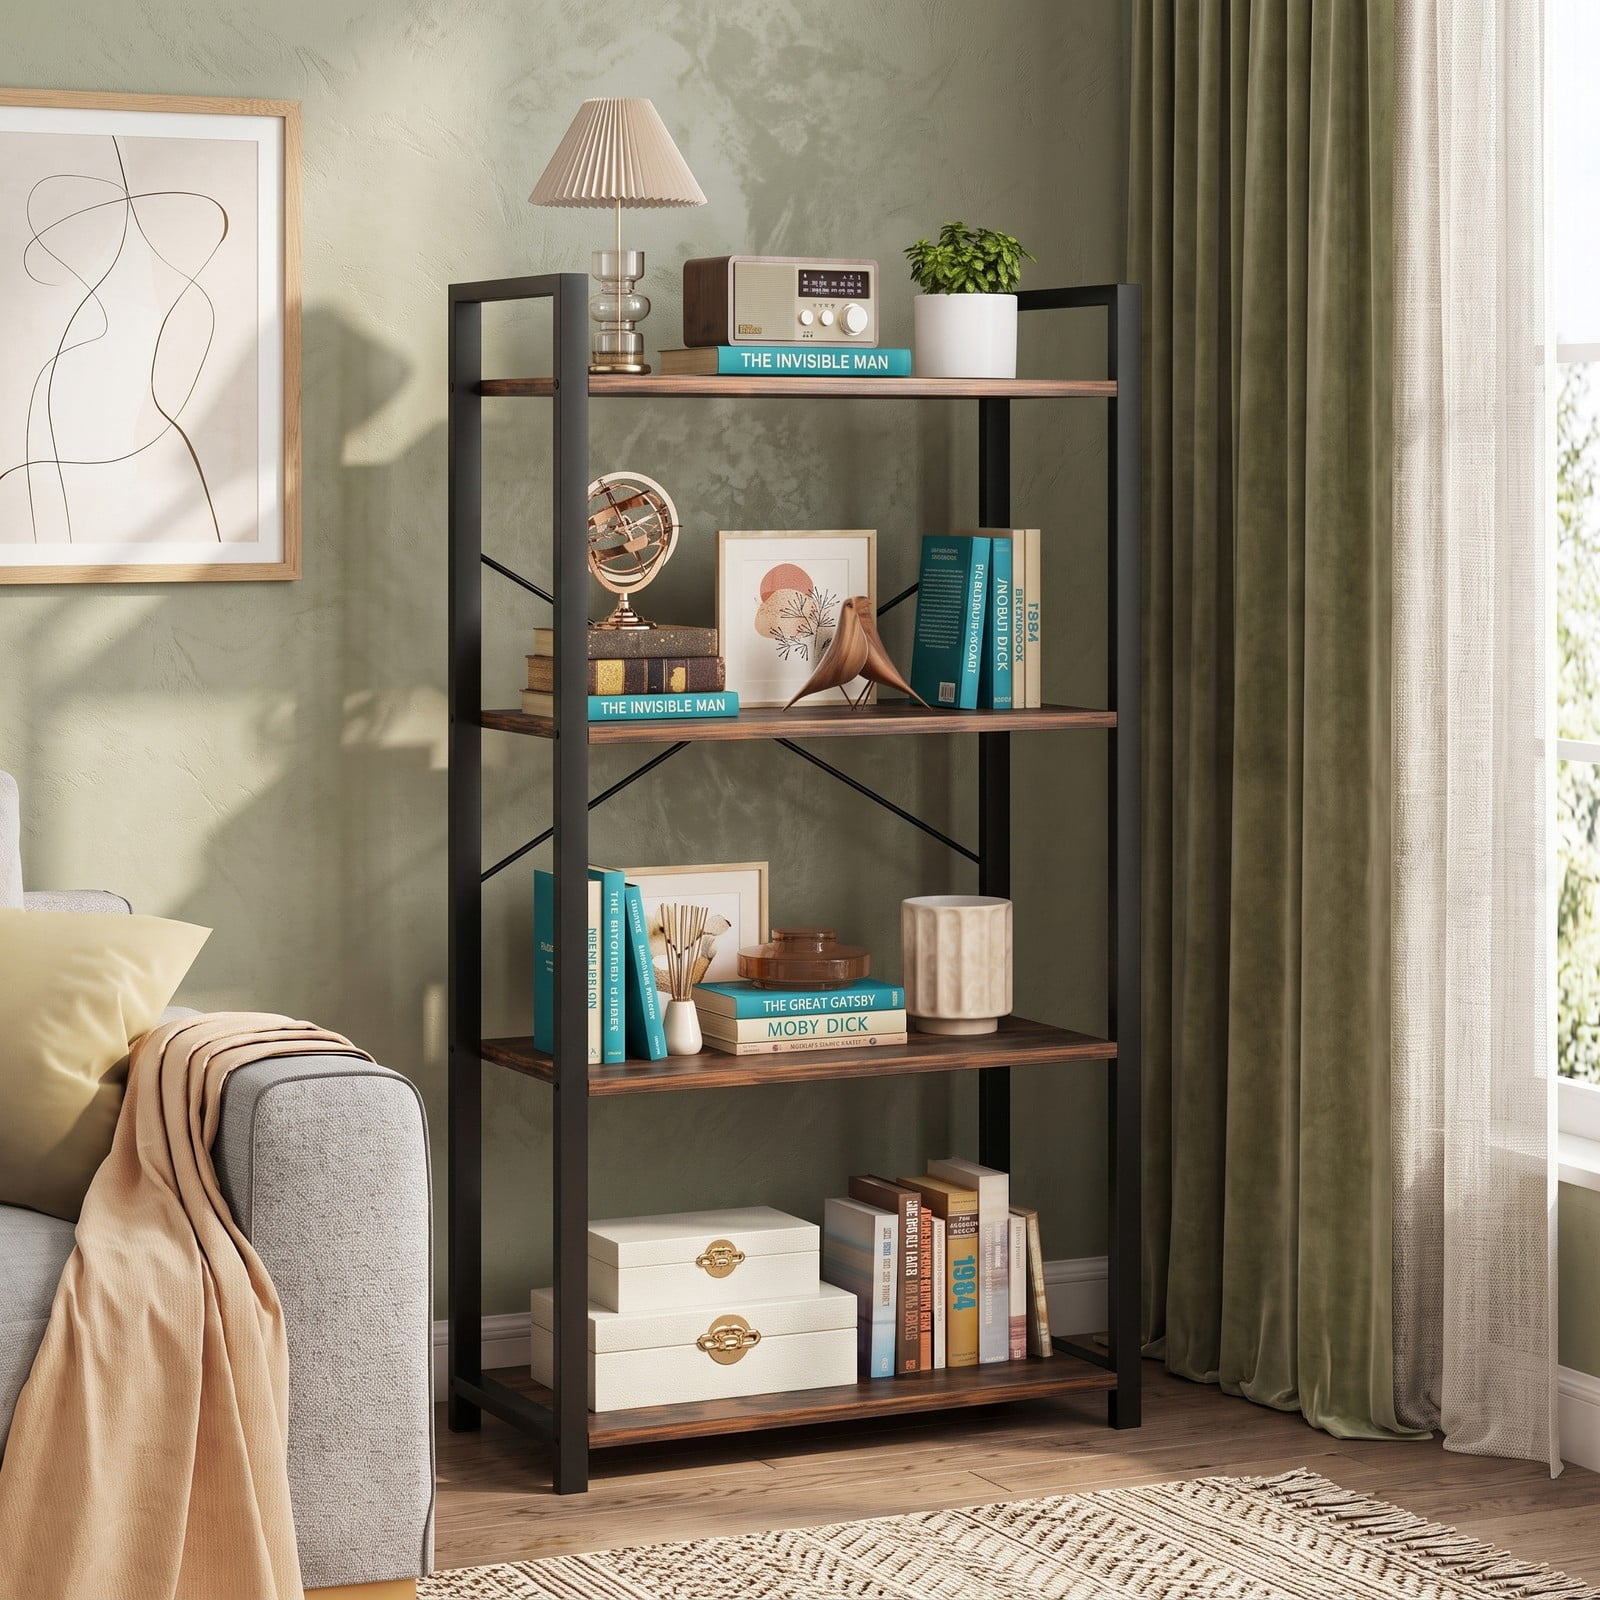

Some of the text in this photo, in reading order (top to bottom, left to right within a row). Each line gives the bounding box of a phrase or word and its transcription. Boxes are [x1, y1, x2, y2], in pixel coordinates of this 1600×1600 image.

[741, 353, 889, 370] THE INVISIBLE MAN
[601, 699, 725, 714] THE INVISIBLE MAN
[610, 891, 619, 915] THE
[763, 1000, 786, 1013] THE
[789, 997, 826, 1011] GREAT
[830, 994, 876, 1008] GATSBY
[767, 1016, 869, 1037] MOBY DICK
[952, 1255, 977, 1312] 1984
